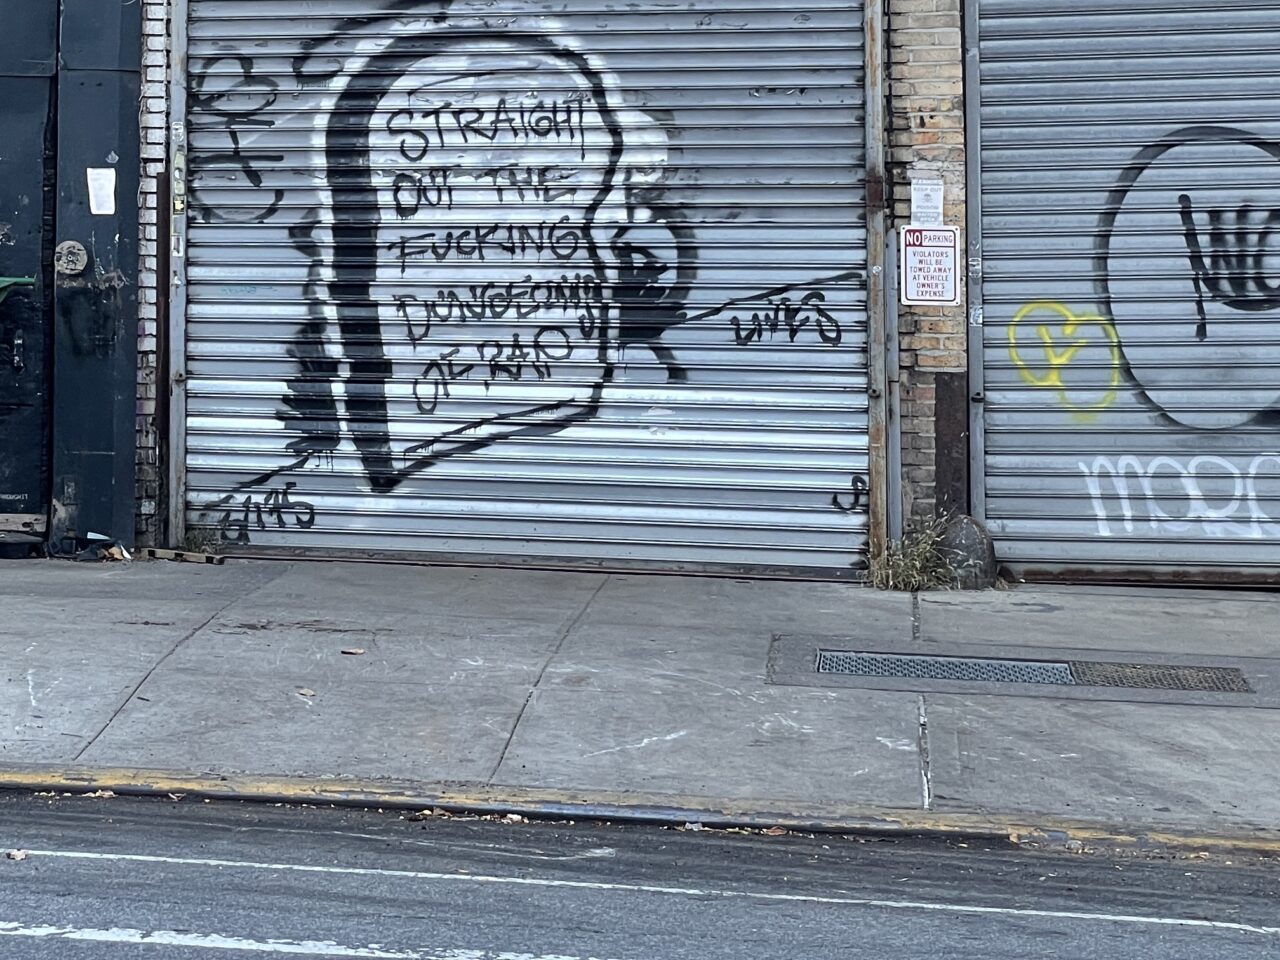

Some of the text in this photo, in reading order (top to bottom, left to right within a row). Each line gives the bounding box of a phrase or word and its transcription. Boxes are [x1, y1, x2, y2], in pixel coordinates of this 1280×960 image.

[386, 97, 592, 162] STRAIGHT
[393, 163, 578, 220] OUT THE
[387, 216, 579, 270] FUCKING
[906, 232, 954, 246] NO PARKING
